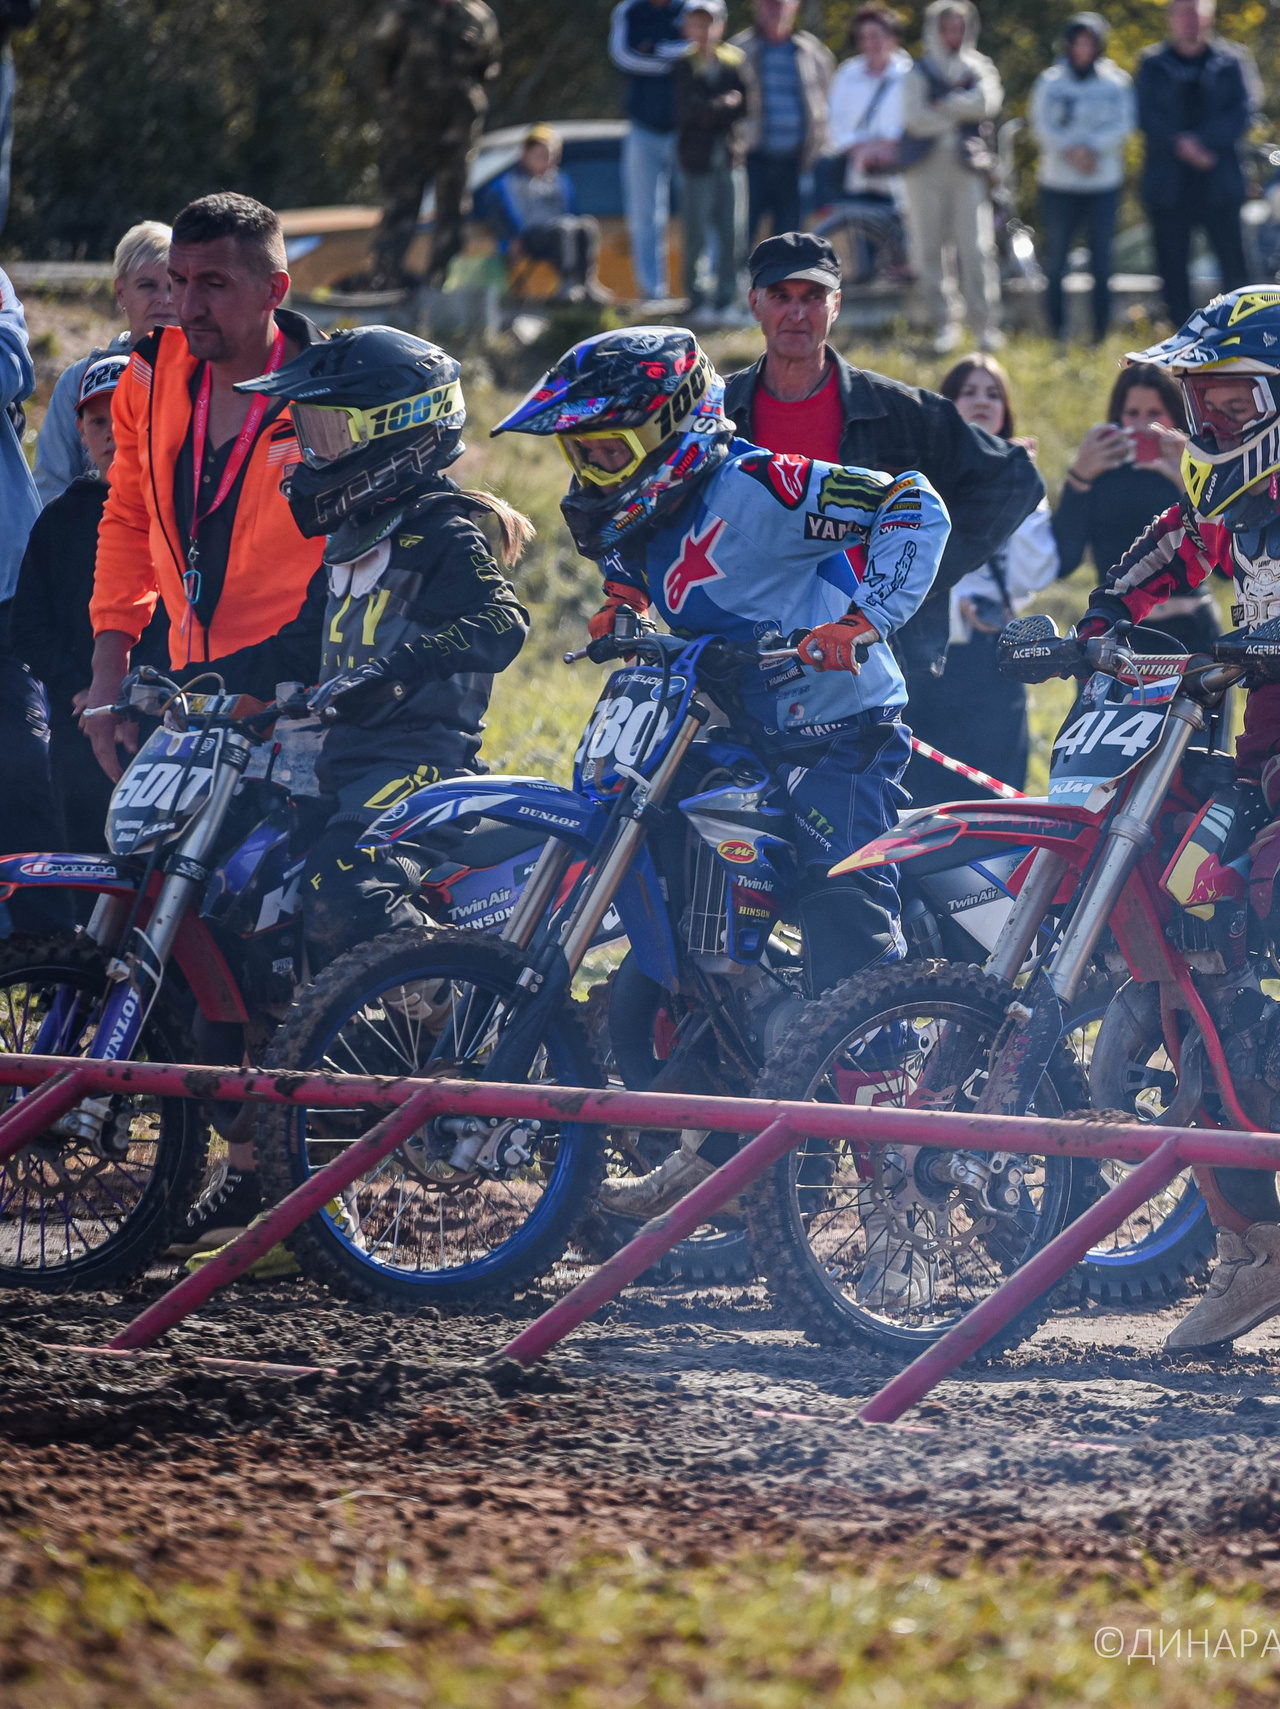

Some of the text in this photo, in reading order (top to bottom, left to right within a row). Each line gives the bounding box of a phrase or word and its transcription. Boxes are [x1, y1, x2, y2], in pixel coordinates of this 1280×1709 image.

[370, 387, 453, 435] 100%
[1205, 472, 1219, 502] Airoh
[1012, 646, 1052, 660] ACERBIS
[1121, 663, 1181, 676] RENTHAL
[1053, 709, 1165, 757] 414
[1050, 780, 1094, 795] KTM
[517, 805, 582, 829] DUNLOP
[722, 845, 756, 858] FMF
[47, 863, 118, 875] MAXIMA
[310, 846, 377, 891] FLY
[738, 905, 771, 919] HINSON
[103, 986, 140, 1060] UNLO
